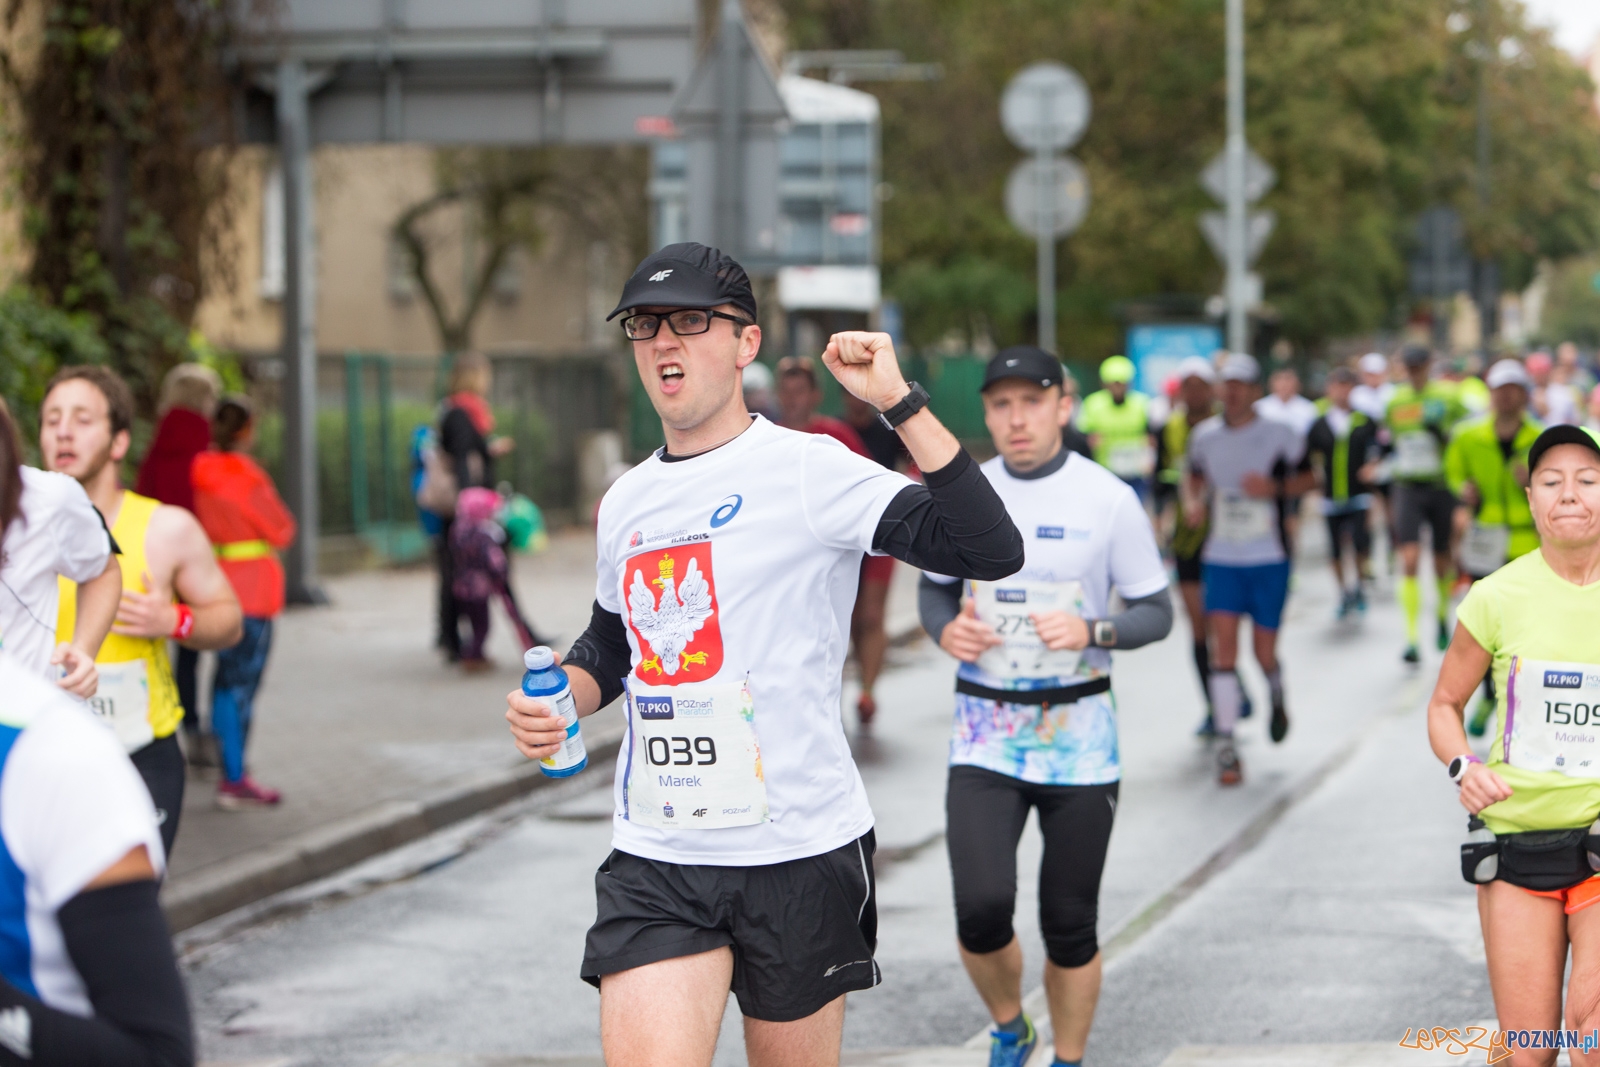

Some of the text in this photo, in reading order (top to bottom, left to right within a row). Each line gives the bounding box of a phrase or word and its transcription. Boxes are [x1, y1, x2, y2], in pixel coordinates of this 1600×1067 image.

[649, 269, 674, 282] 4F
[671, 532, 710, 544] 11.11.2015
[1555, 731, 1595, 743] Monika
[659, 774, 702, 788] Marek
